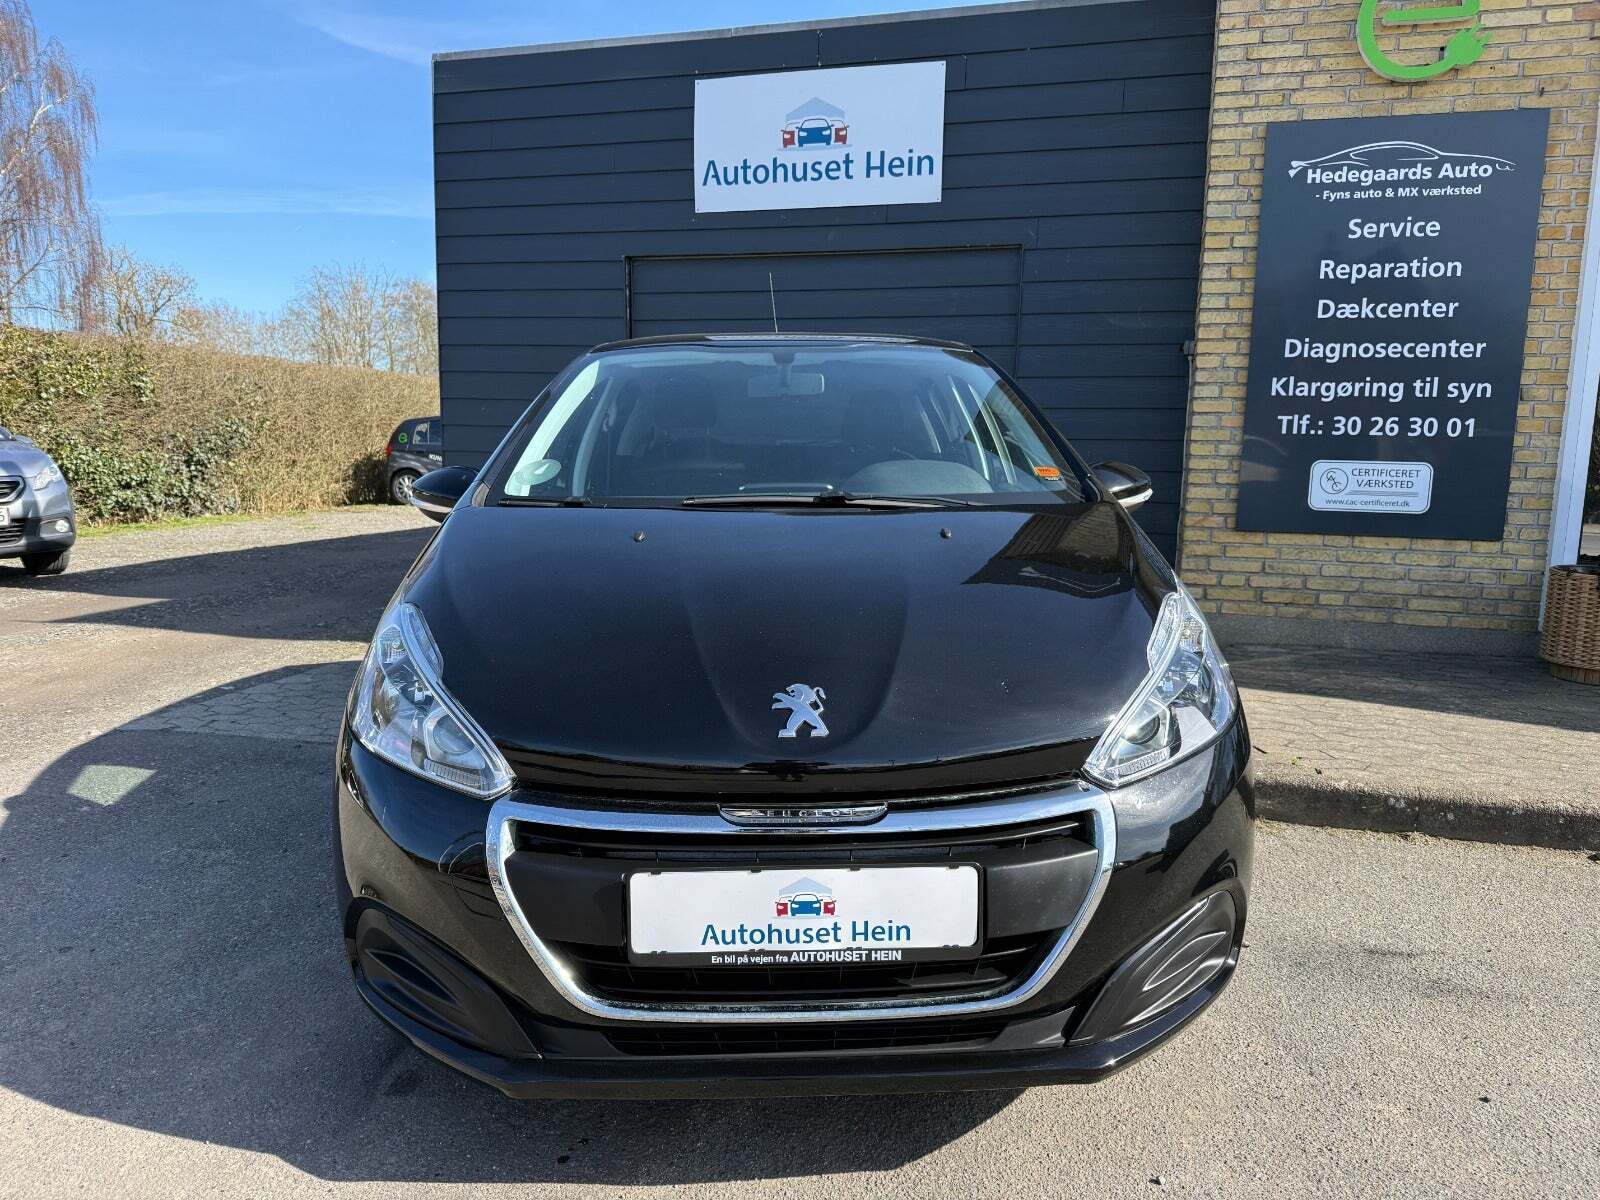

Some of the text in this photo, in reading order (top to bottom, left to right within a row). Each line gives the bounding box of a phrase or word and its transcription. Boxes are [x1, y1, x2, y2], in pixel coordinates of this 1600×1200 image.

[702, 148, 934, 187] Autohuset Hein
[1306, 162, 1493, 186] Hedegaards Auto
[1322, 190, 1351, 202] Fyns
[1353, 188, 1383, 199] auto
[1384, 187, 1395, 198] &
[1397, 186, 1419, 197] MX
[1422, 183, 1482, 196] værksted
[1348, 216, 1441, 239] Service
[1319, 256, 1462, 284] Reparation
[1317, 297, 1460, 319] Dækcenter
[1284, 337, 1487, 364] Diagnosecenter
[1271, 375, 1492, 404] Klargøring til syn
[1277, 414, 1475, 438] Tlf.: 30 26 30 01
[1351, 468, 1421, 479] CERTIFICERET
[1356, 479, 1415, 490] VÆRKSTED
[1325, 498, 1411, 508] www.cac-certificeret.dk
[701, 919, 911, 946] Autohuset Hein
[711, 949, 902, 965] En bil på vejen fra AUTOHUSET HEIN
